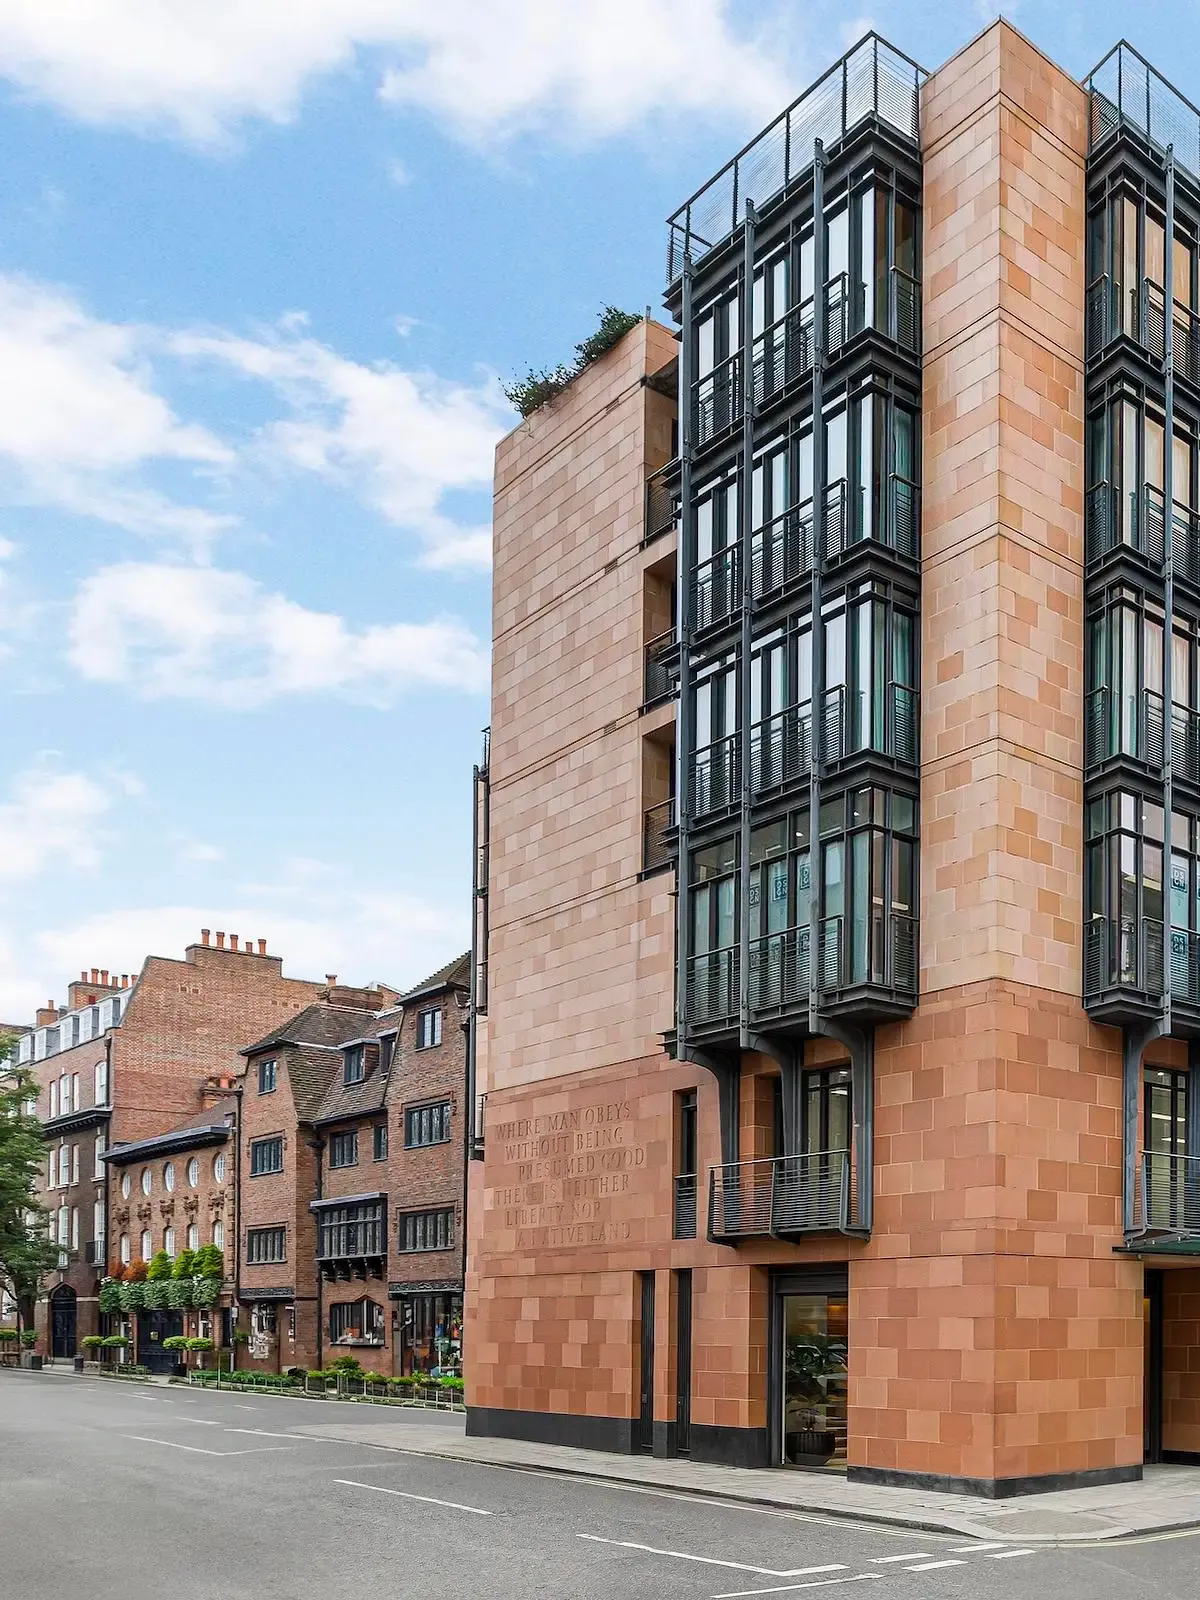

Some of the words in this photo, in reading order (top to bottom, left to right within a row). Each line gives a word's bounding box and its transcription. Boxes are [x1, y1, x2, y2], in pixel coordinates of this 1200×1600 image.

[496, 1118, 541, 1140] WHERE
[548, 1112, 580, 1132] MAN
[585, 1102, 631, 1125] OBEYS
[505, 1136, 570, 1161] WITHOUT
[576, 1127, 623, 1150] BEING
[519, 1155, 595, 1181] PRESUMED
[601, 1147, 644, 1170] GOOD
[544, 1183, 557, 1200] IS
[506, 1205, 564, 1226] LIBERTY
[571, 1201, 601, 1221] NOR
[590, 1221, 631, 1241] LAND
